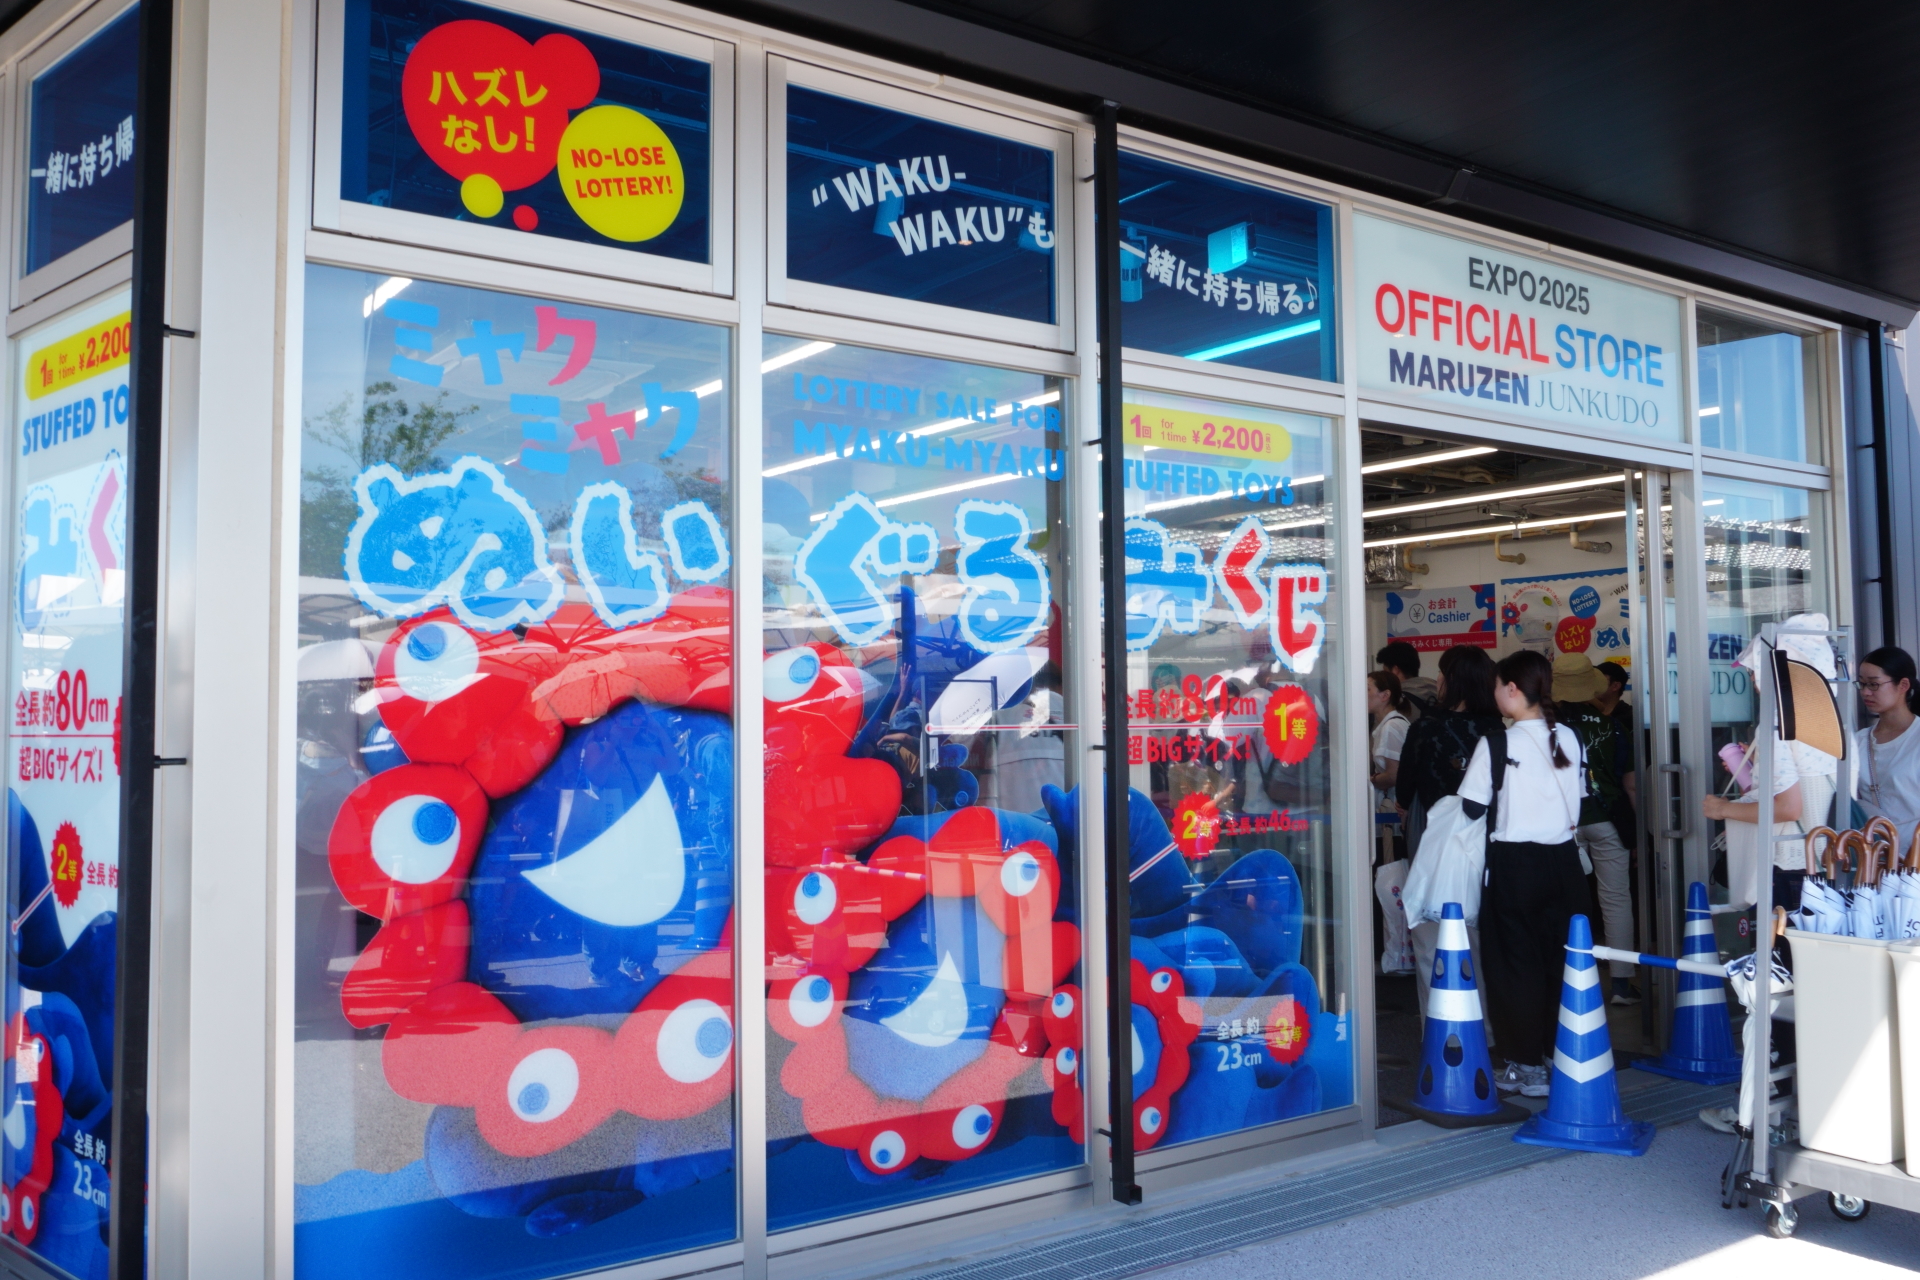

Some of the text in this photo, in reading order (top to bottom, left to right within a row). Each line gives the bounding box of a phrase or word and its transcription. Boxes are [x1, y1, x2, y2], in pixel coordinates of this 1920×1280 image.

[428, 68, 549, 108] ハズレ
[440, 114, 536, 154] なし!
[571, 146, 666, 168] NO-LOSE
[575, 175, 673, 199] LOTTERY!
[1374, 283, 1664, 387] OFFICIAL STORE
[58, 353, 68, 366] for
[63, 365, 76, 379] time
[1389, 348, 1659, 428] MARUZEN JUNKUDO
[793, 372, 1062, 433] LOTTERY SALE FOR
[22, 396, 96, 457] STUFFED
[1161, 418, 1174, 430] for
[1161, 431, 1187, 443] 1 time
[1192, 422, 1264, 453] ¥2,200
[793, 419, 1065, 482] MYAKU-MYAKU
[1123, 458, 1295, 507] TUFFED TOYS
[1428, 597, 1457, 611] お会計
[1571, 591, 1595, 606] NO-LOSE
[1574, 598, 1599, 613] LOTTERY!
[1428, 610, 1471, 624] Cashier
[1406, 637, 1453, 650] るみくじ専用
[1559, 624, 1586, 641] ハズレ
[1563, 635, 1585, 650] なし!
[1273, 702, 1307, 741] 1等
[1216, 1016, 1260, 1041] 全長約
[1217, 1043, 1262, 1072] 23cm
[72, 1160, 107, 1209] 23cm
